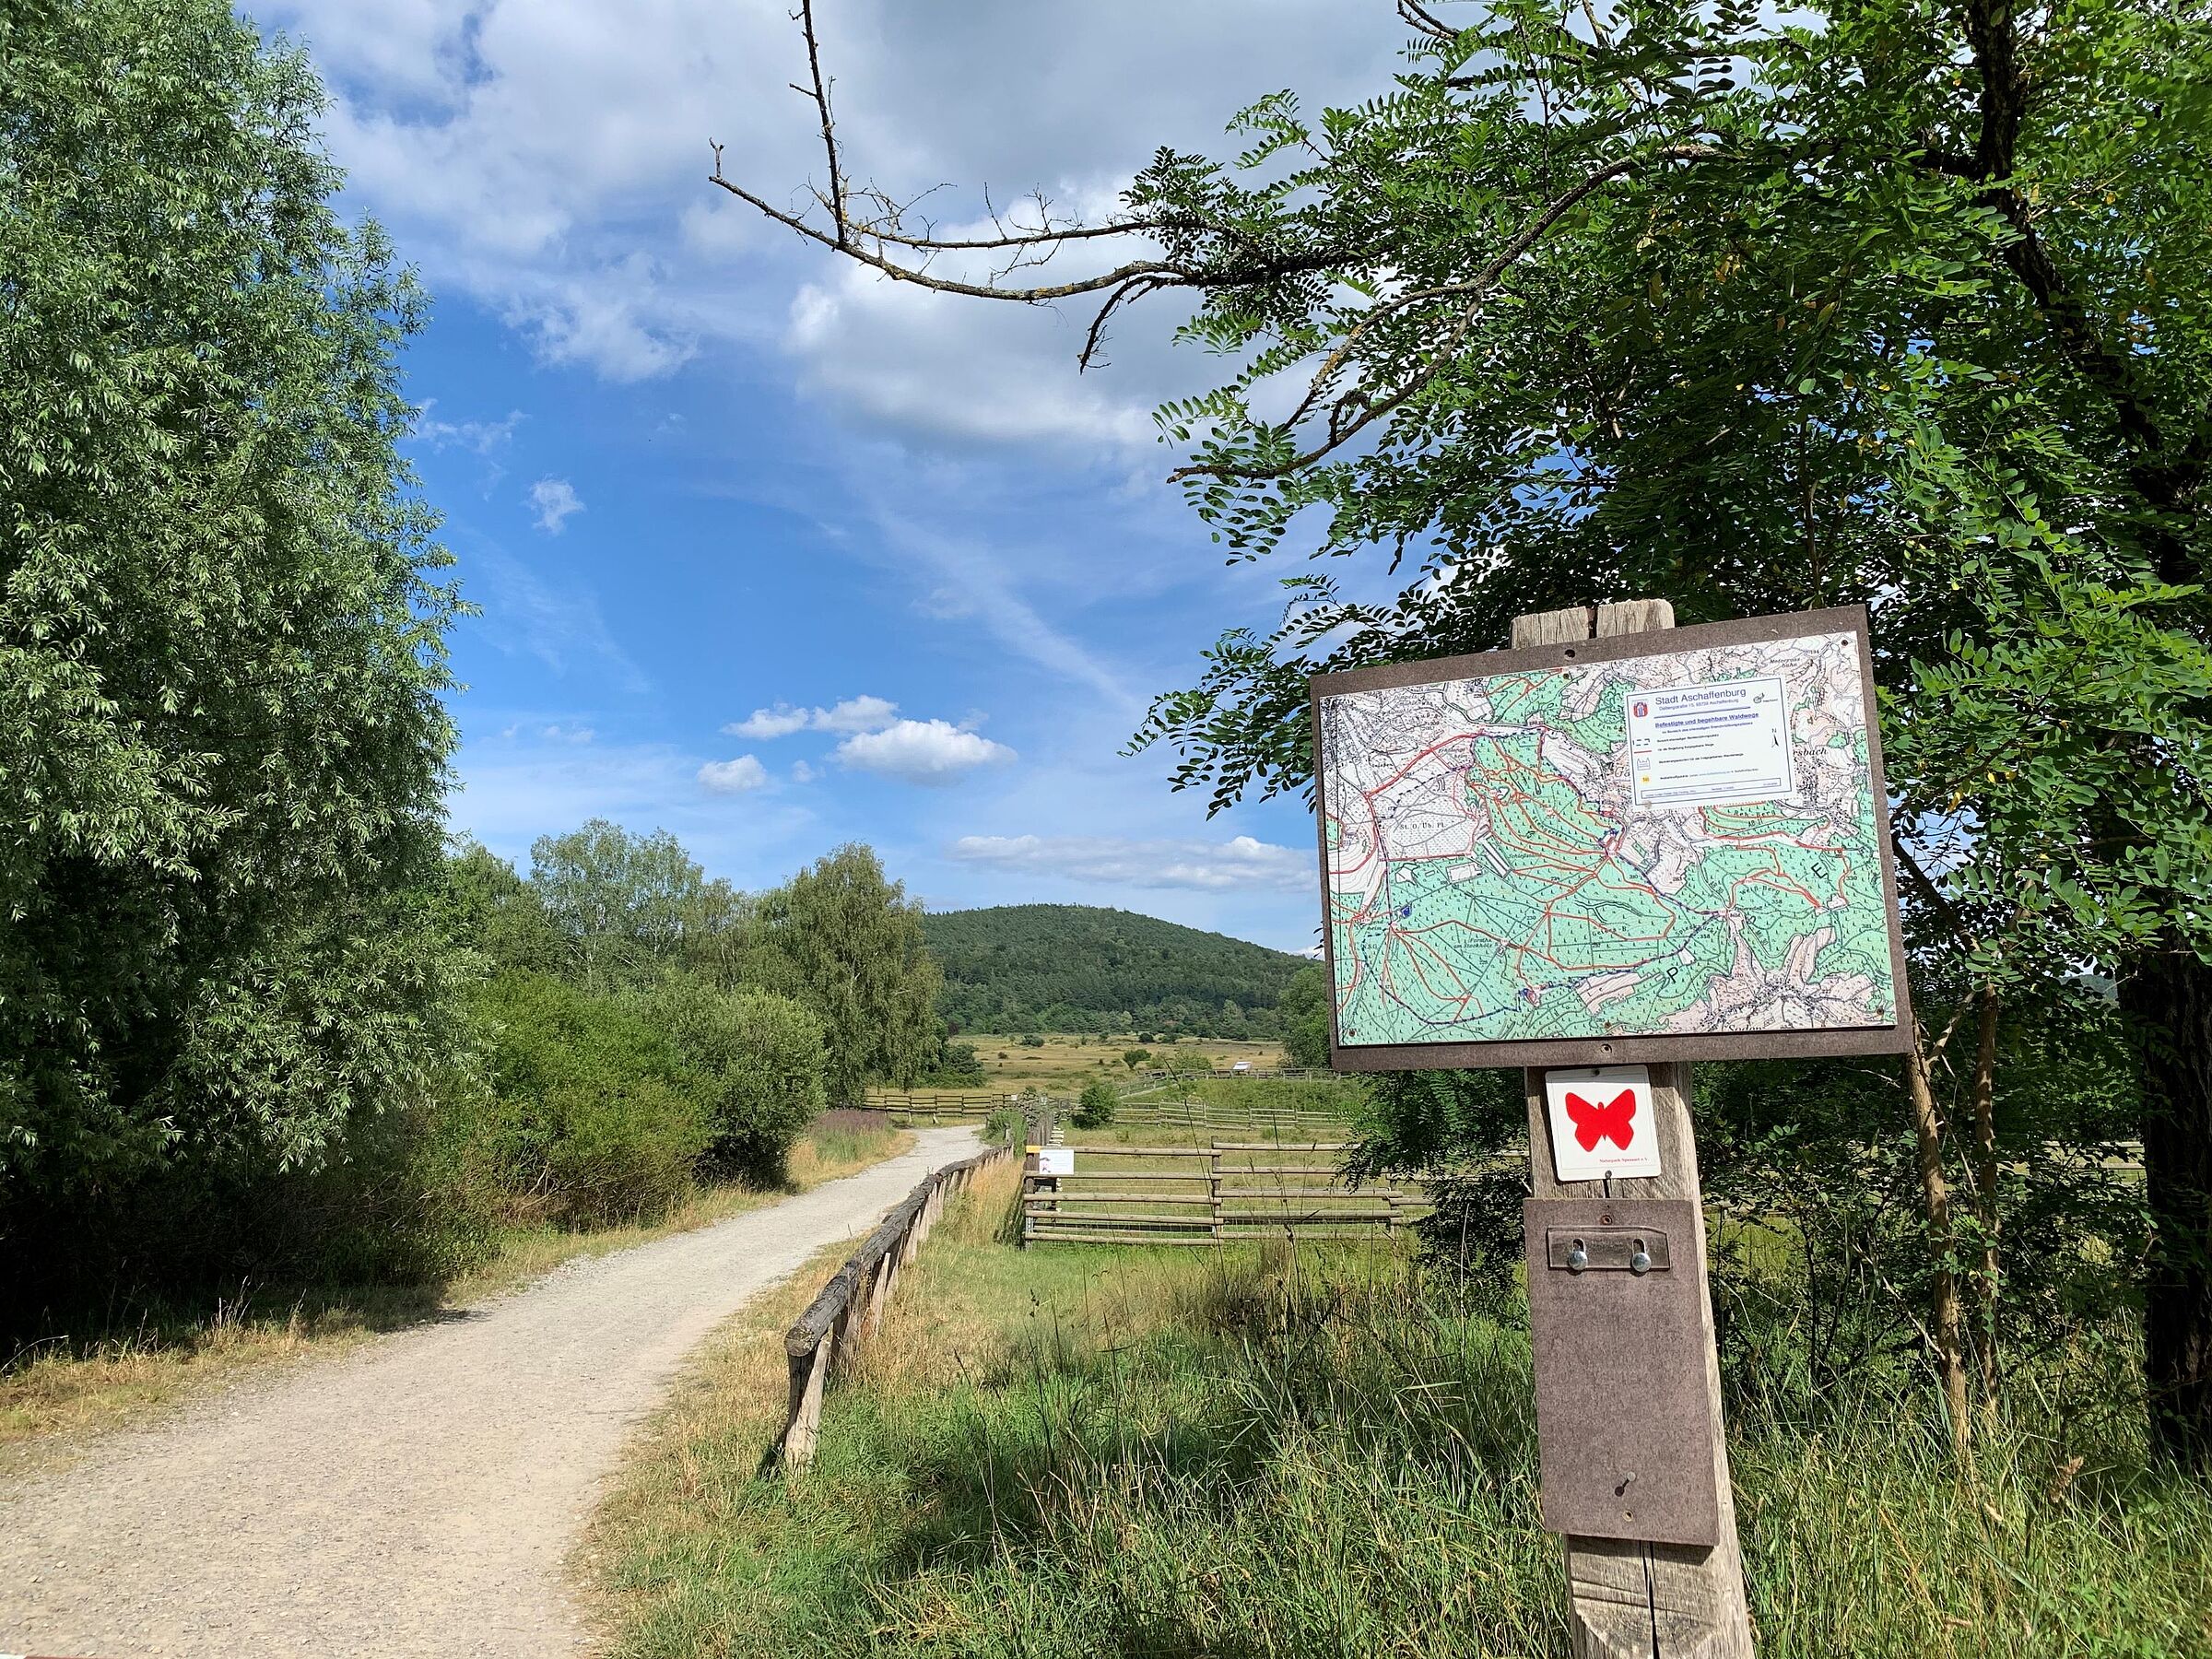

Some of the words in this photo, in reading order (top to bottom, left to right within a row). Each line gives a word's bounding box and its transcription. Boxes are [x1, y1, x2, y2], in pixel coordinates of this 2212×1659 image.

[1655, 695, 1678, 705] Stadt
[1681, 689, 1746, 701] Aschaffenburg
[1811, 863, 1829, 878] E
[1666, 967, 1678, 984] P
